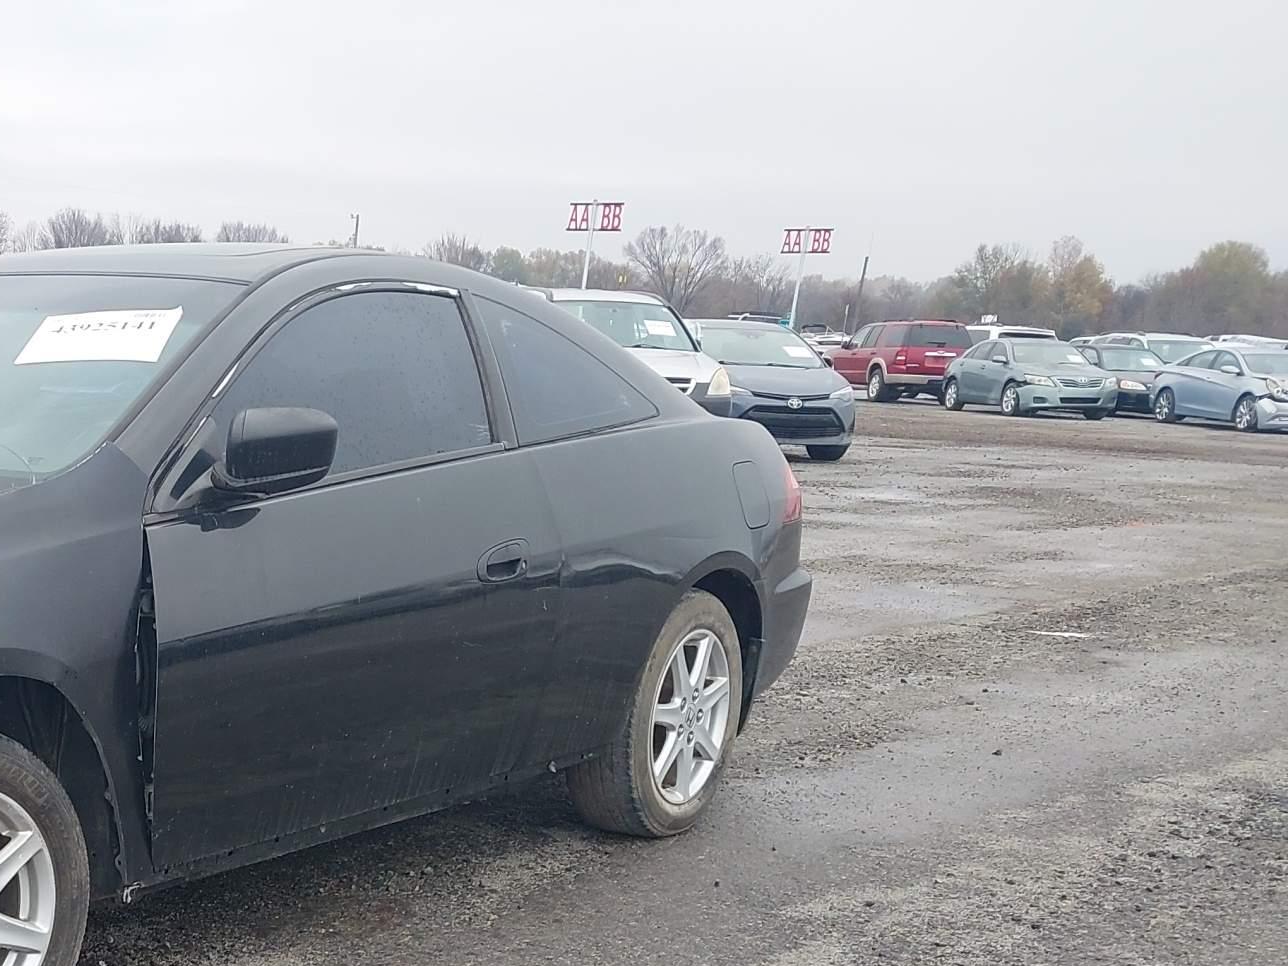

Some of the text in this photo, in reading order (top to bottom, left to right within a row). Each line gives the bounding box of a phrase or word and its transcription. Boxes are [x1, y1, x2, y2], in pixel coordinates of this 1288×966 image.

[568, 203, 623, 230] AA BB
[780, 229, 832, 253] AA BB
